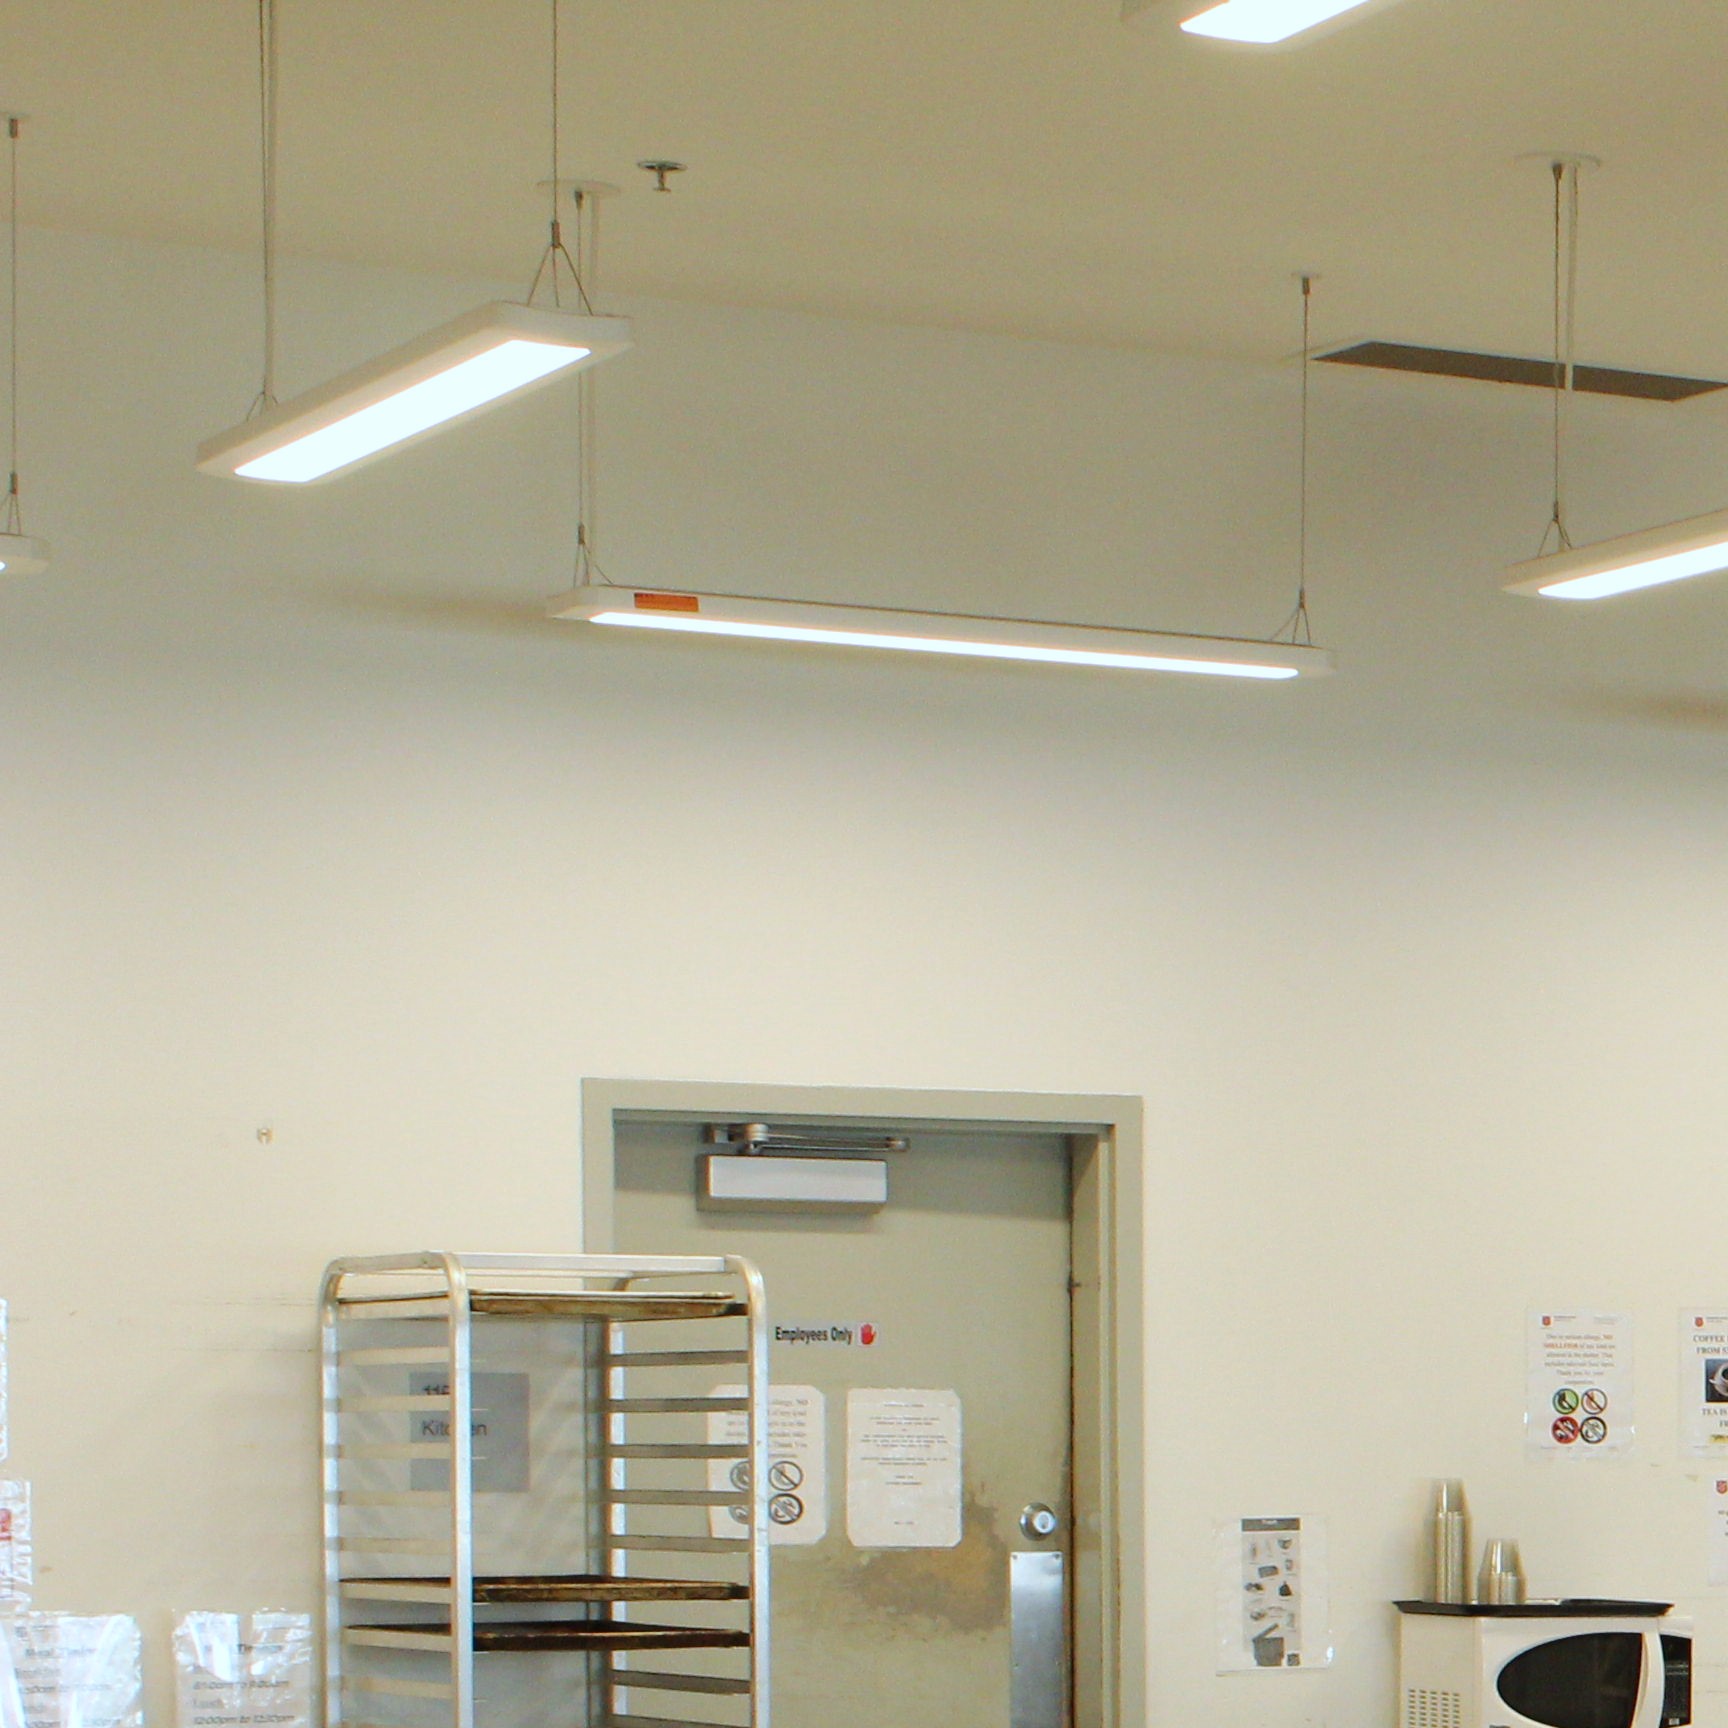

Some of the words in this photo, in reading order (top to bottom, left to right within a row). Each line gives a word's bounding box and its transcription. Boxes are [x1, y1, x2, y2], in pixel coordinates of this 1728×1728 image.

[774, 1326, 828, 1344] Employees
[831, 1327, 852, 1345] Only
[1692, 1335, 1725, 1343] COFFEE
[1696, 1346, 1720, 1354] FROM
[1702, 1408, 1718, 1416] TEA
[1720, 1408, 1728, 1416] IS
